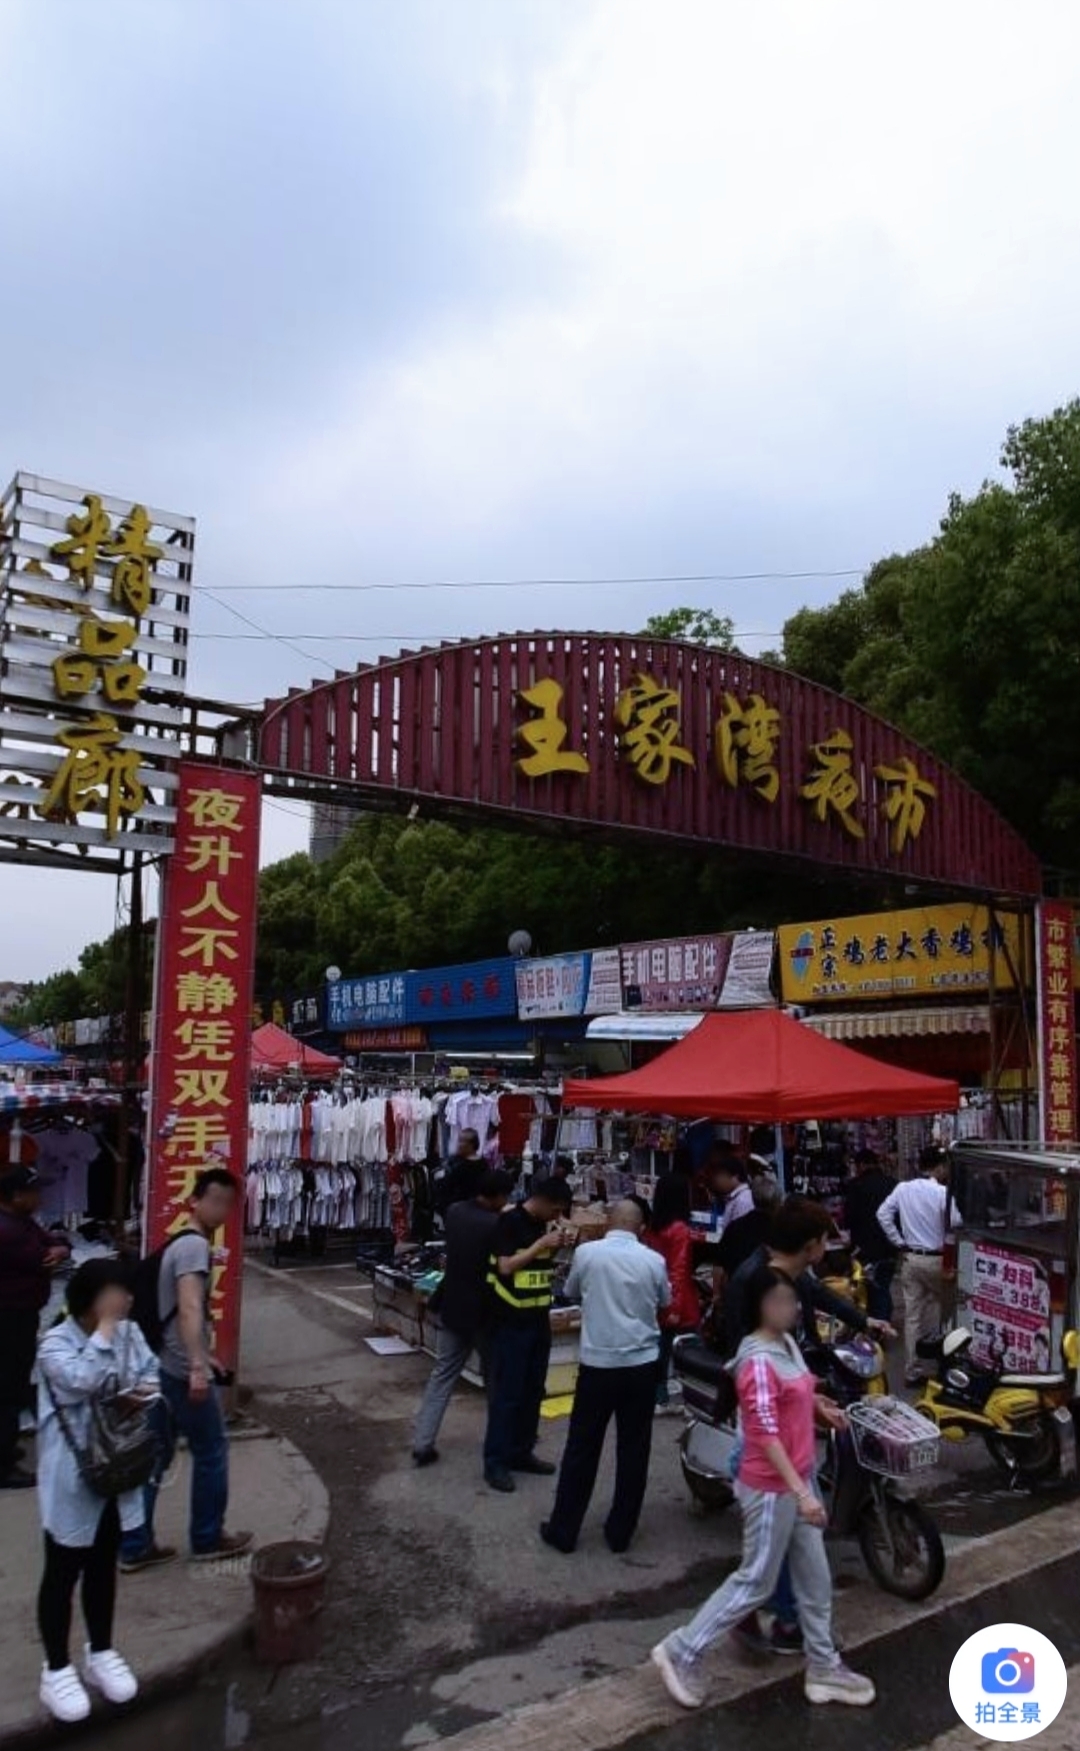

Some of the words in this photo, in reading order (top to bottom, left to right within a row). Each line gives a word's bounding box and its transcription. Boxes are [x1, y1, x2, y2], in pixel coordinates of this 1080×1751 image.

[515, 672, 938, 855] 王家湾夜市
[621, 942, 718, 987] 手机电脑配件
[819, 926, 837, 979] 正宗
[328, 975, 405, 1010] 手机电脑配件
